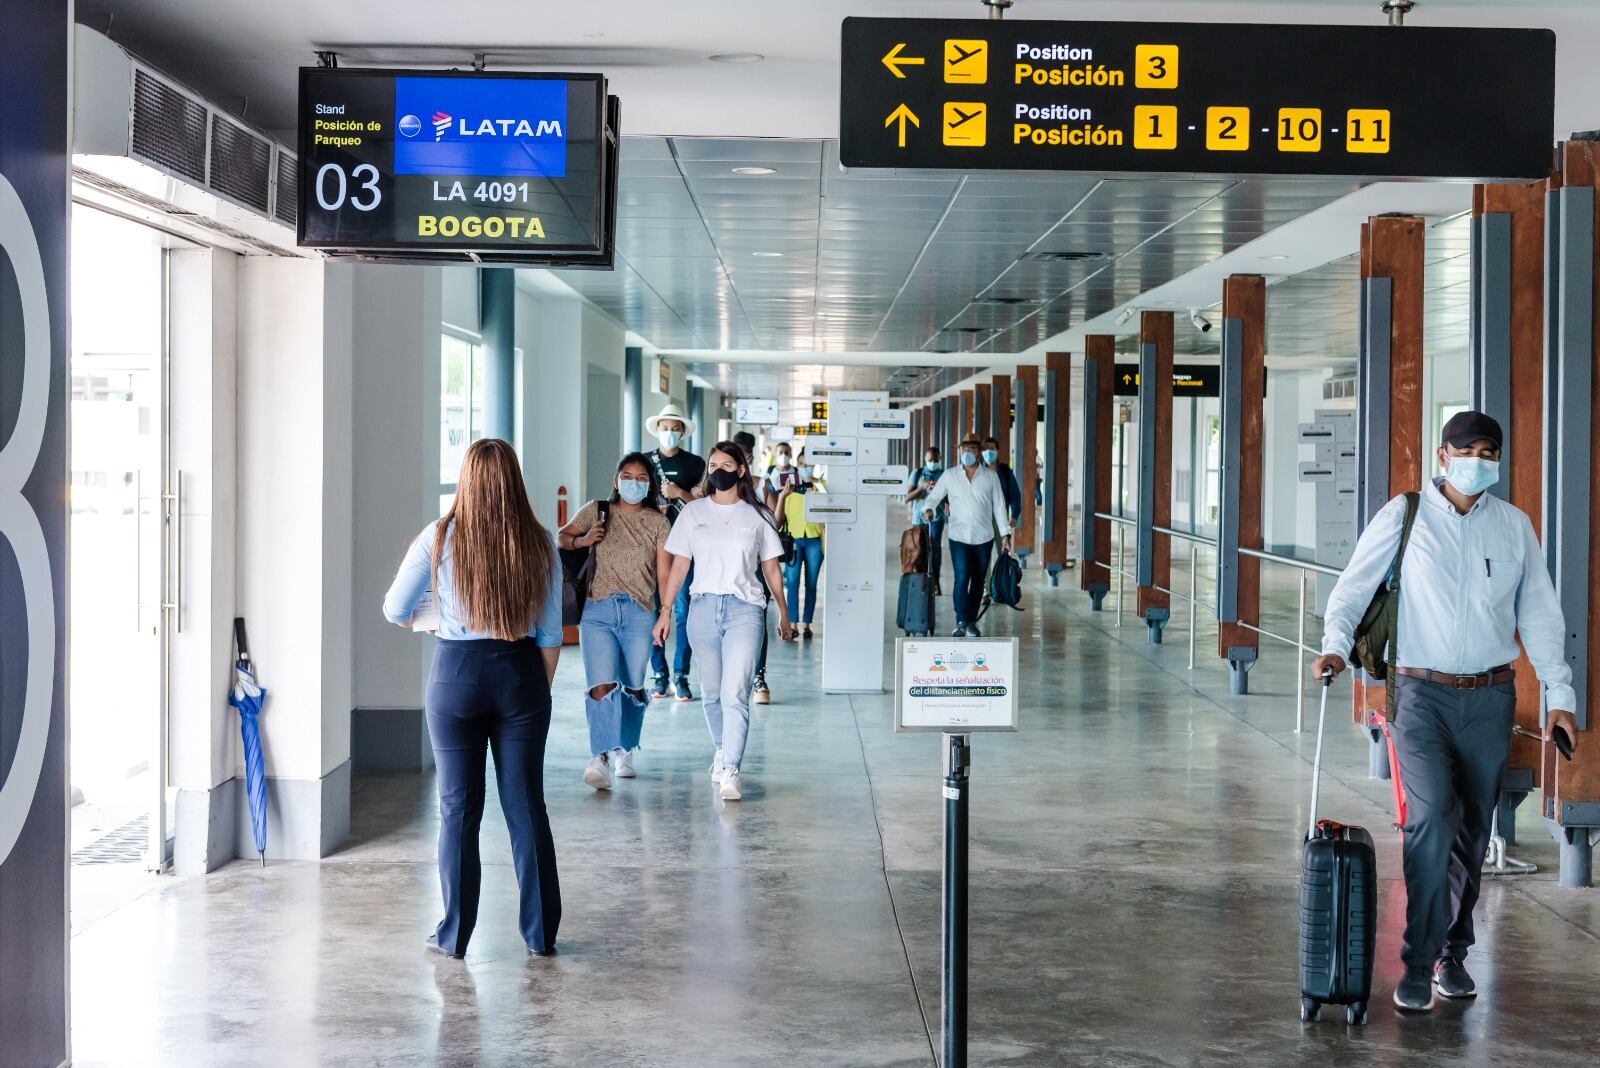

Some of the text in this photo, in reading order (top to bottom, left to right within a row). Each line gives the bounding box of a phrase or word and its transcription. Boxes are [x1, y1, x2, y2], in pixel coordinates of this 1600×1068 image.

[1017, 44, 1093, 60] Position
[1015, 64, 1124, 86] Posición
[1147, 57, 1167, 80] 3
[316, 104, 345, 114] Stand
[1016, 104, 1091, 120] Position
[315, 120, 381, 131] Posición de
[460, 119, 562, 137] LATAM
[1148, 115, 1163, 138] 1
[1219, 117, 1237, 140] 2
[1280, 118, 1318, 141] 10
[1350, 119, 1387, 142] 11
[315, 136, 362, 147] Parqueo
[1014, 124, 1123, 146] Posición
[316, 163, 381, 211] 03
[433, 181, 528, 203] LA 4091
[418, 216, 545, 238] BOGOTA
[913, 675, 1004, 687] Respeta la señalización
[910, 687, 923, 695] del
[924, 687, 985, 695] distanciamiento
